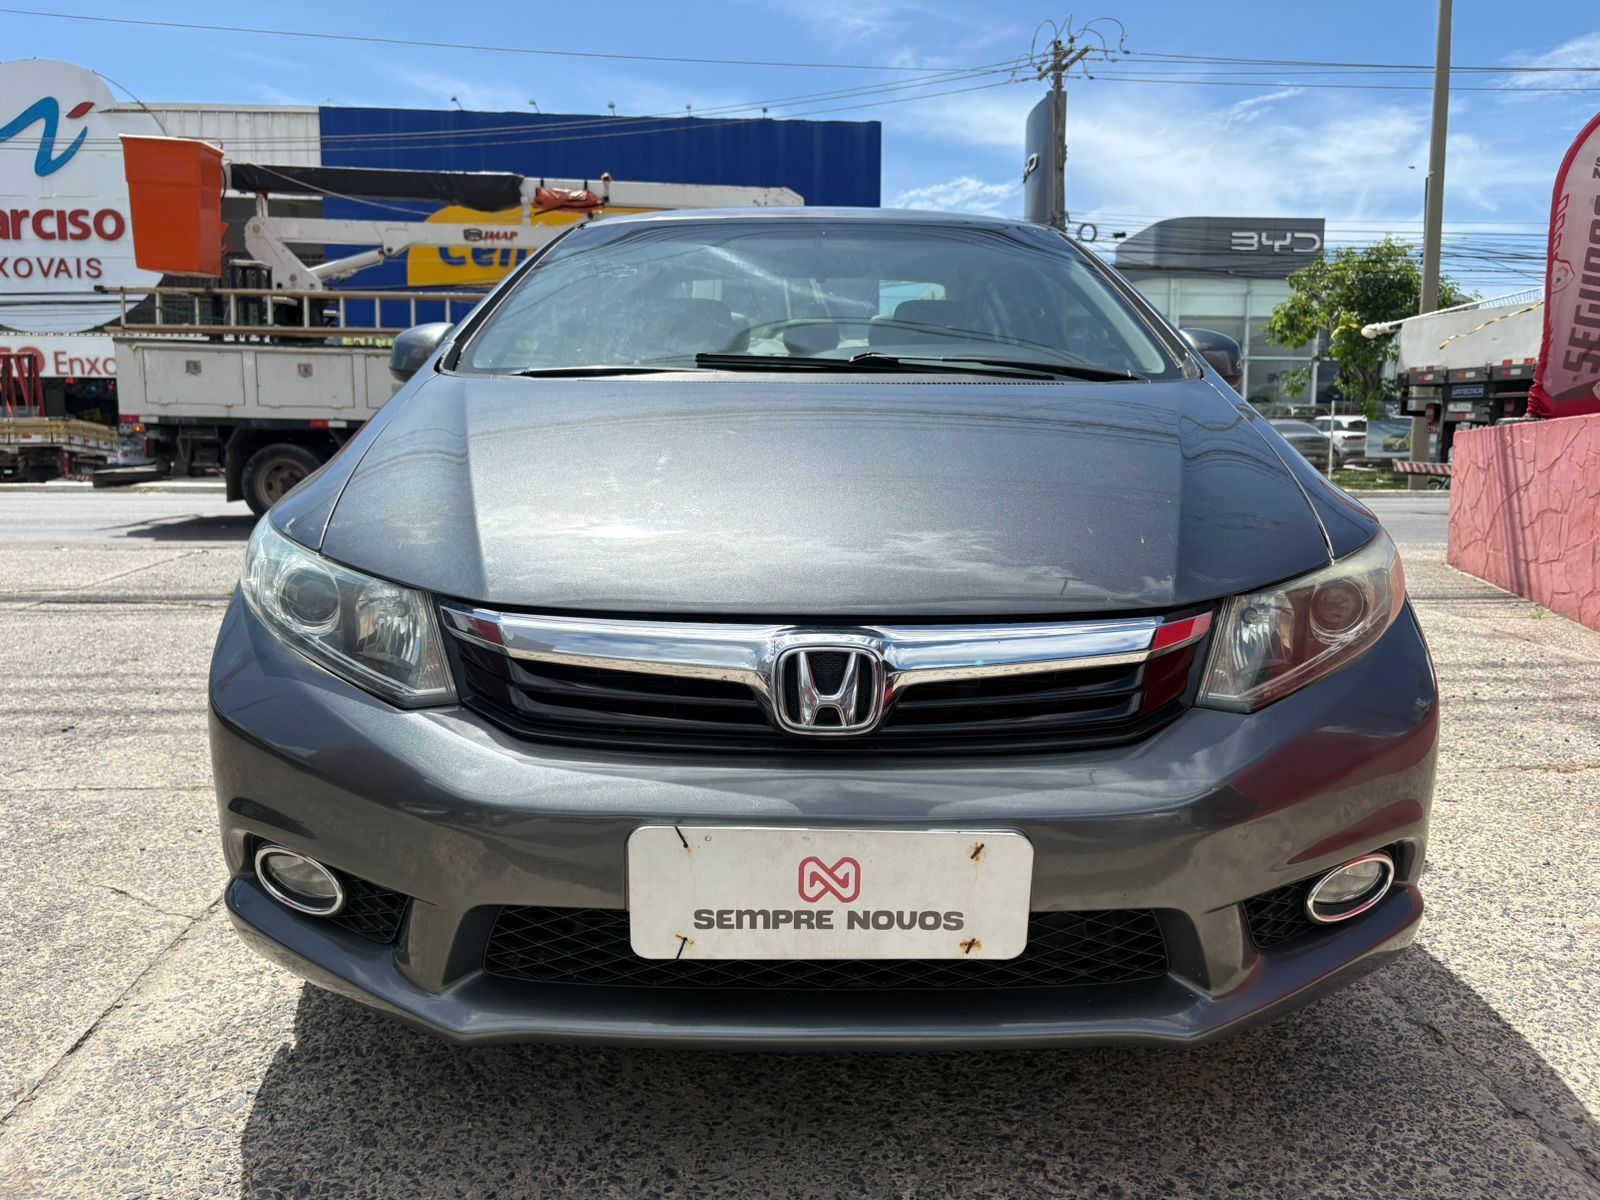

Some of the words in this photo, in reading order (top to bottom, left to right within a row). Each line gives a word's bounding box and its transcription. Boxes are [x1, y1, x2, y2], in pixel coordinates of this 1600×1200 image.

[1231, 232, 1321, 253] BYD
[693, 908, 834, 930] SEMPRE
[847, 910, 965, 931] NOVOS
